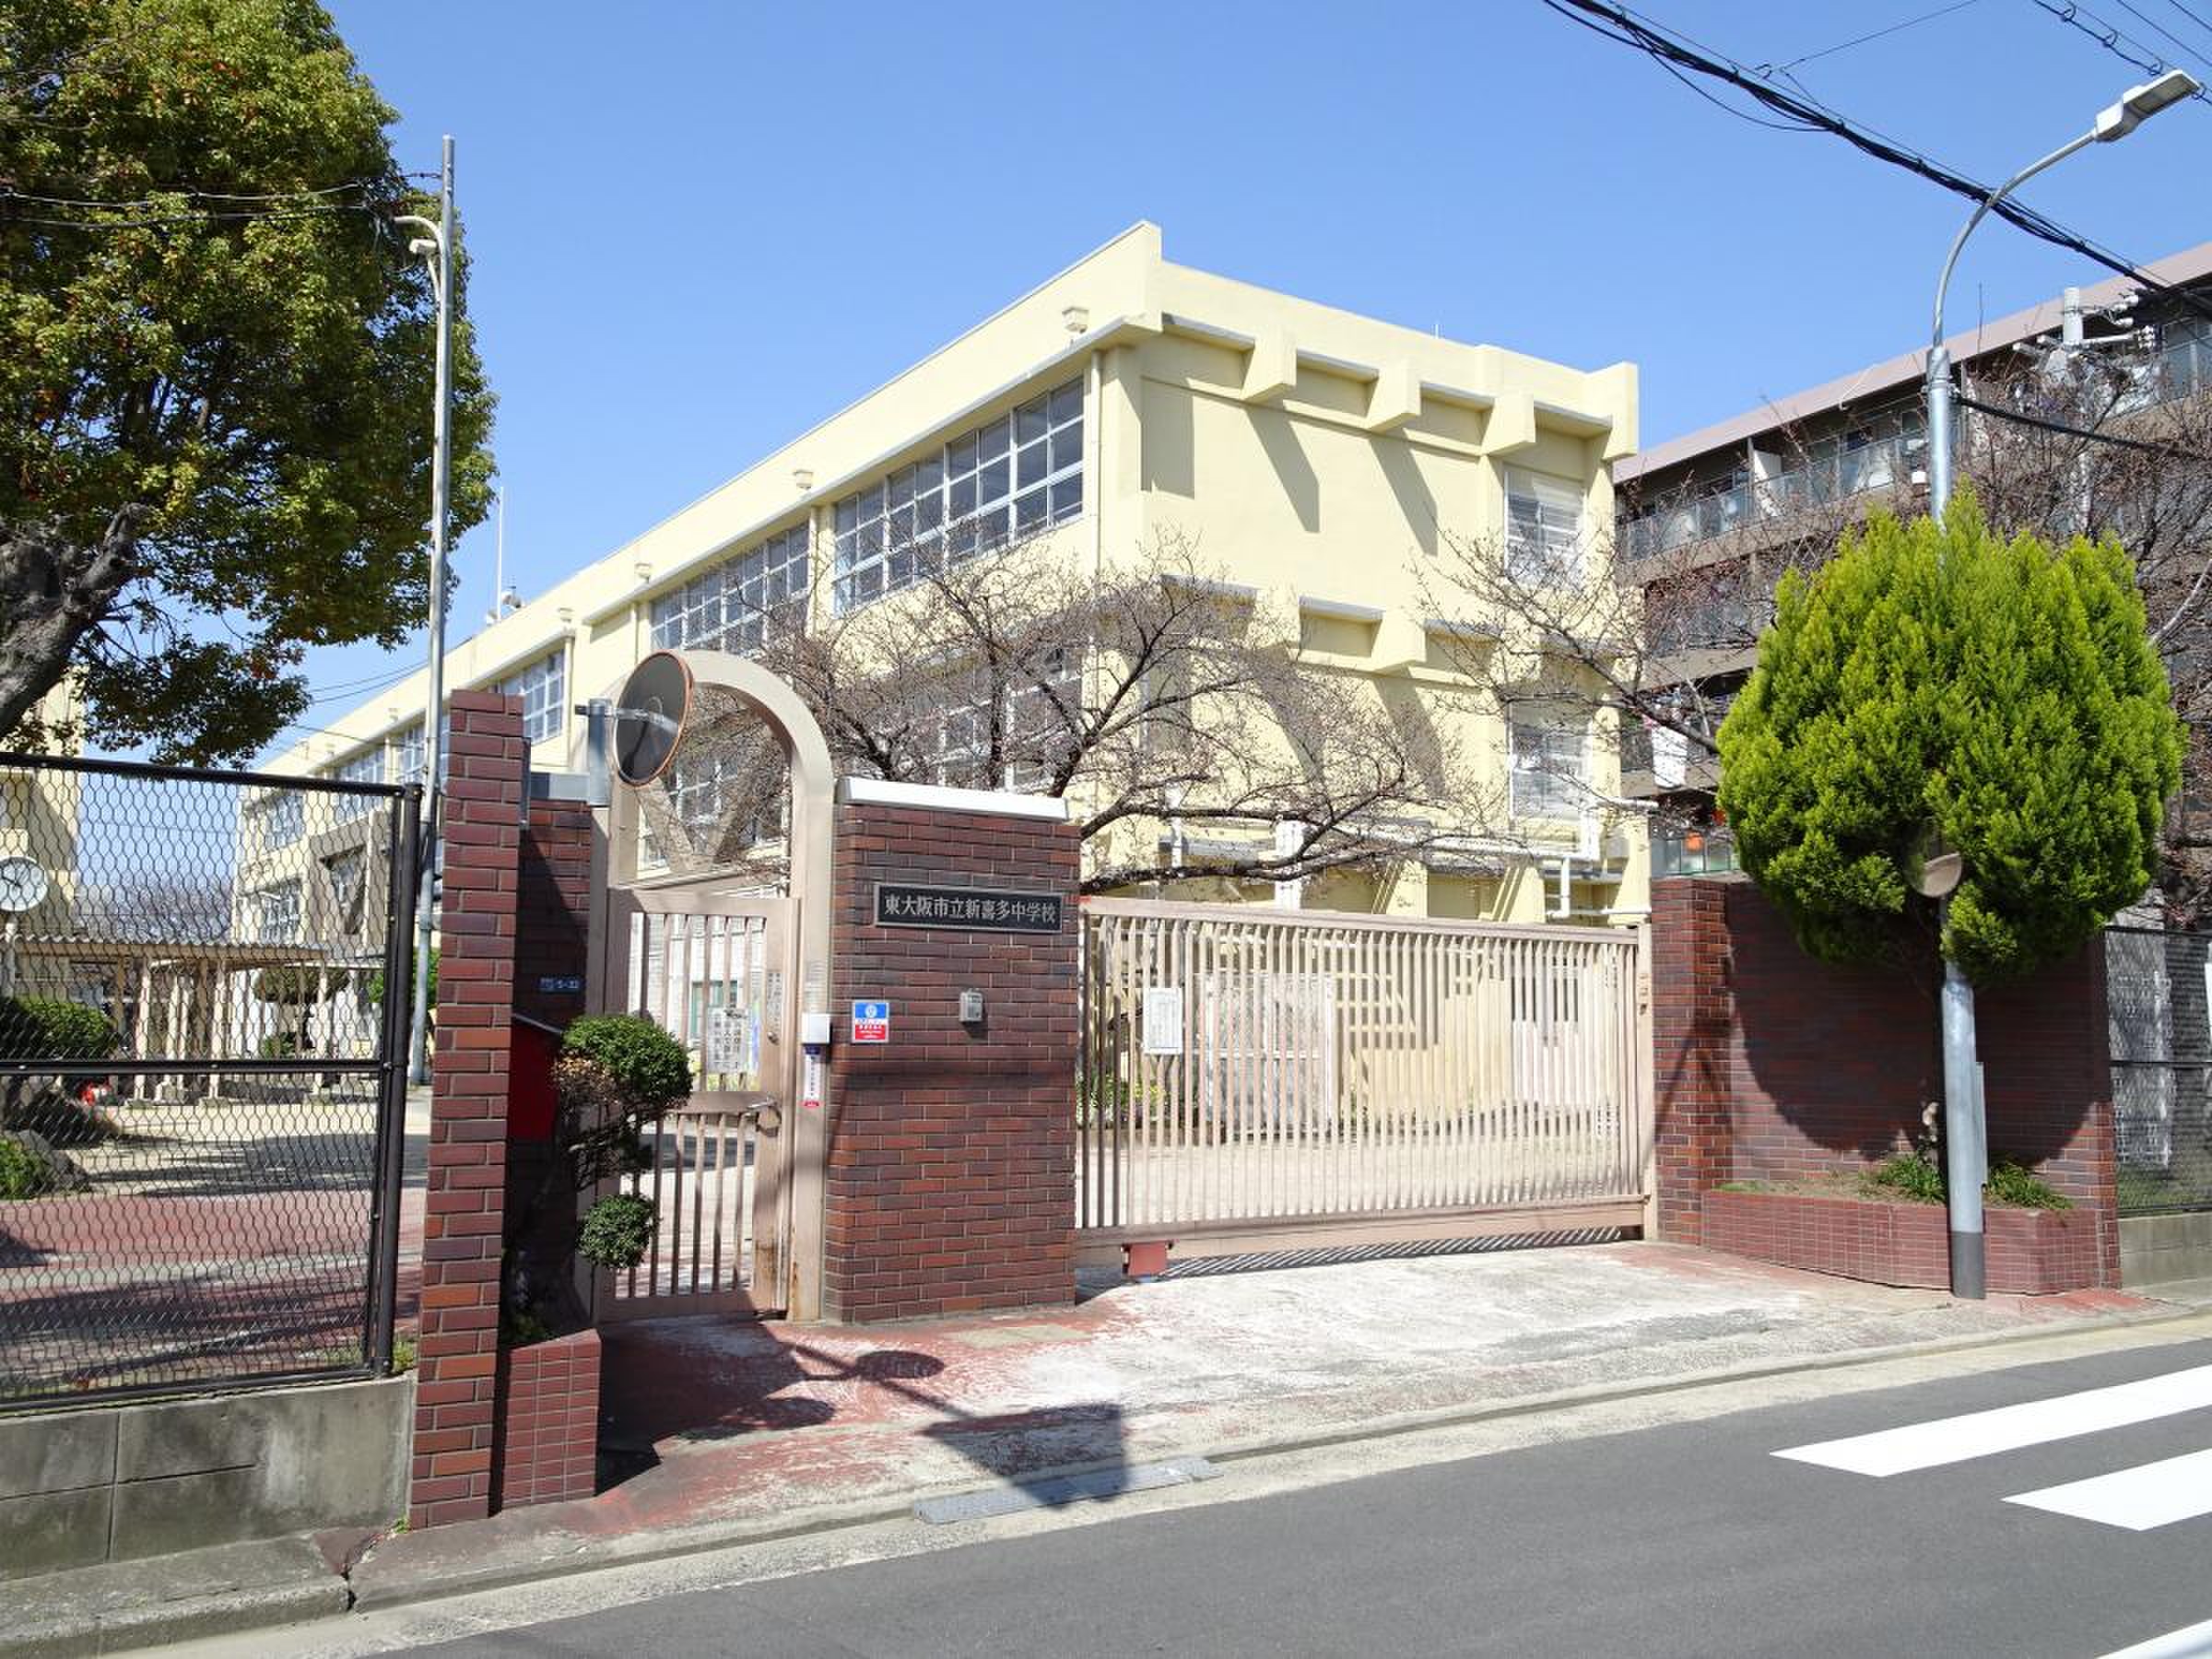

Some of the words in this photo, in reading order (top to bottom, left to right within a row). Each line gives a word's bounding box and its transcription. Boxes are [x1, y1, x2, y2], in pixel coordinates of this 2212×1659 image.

[884, 893, 1057, 924] 東大阪市立新喜多中学校
